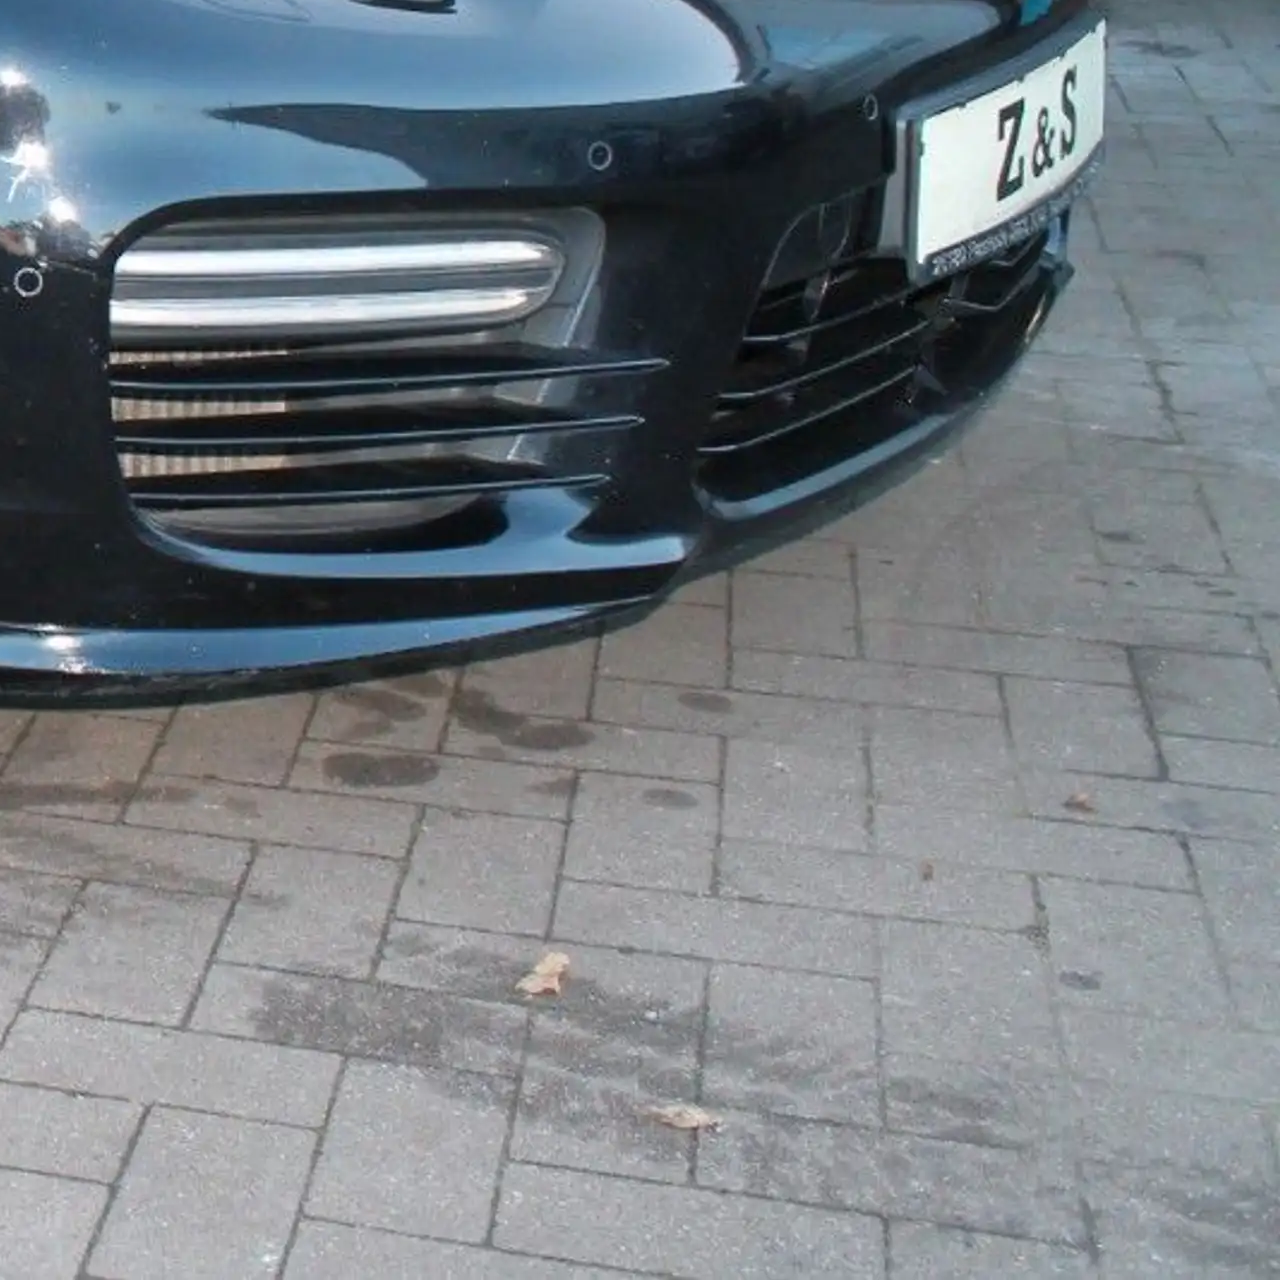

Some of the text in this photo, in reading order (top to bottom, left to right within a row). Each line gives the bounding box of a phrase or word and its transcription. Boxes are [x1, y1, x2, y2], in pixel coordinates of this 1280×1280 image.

[996, 97, 1025, 202] Z
[1031, 106, 1056, 178] &
[1059, 64, 1078, 161] S
